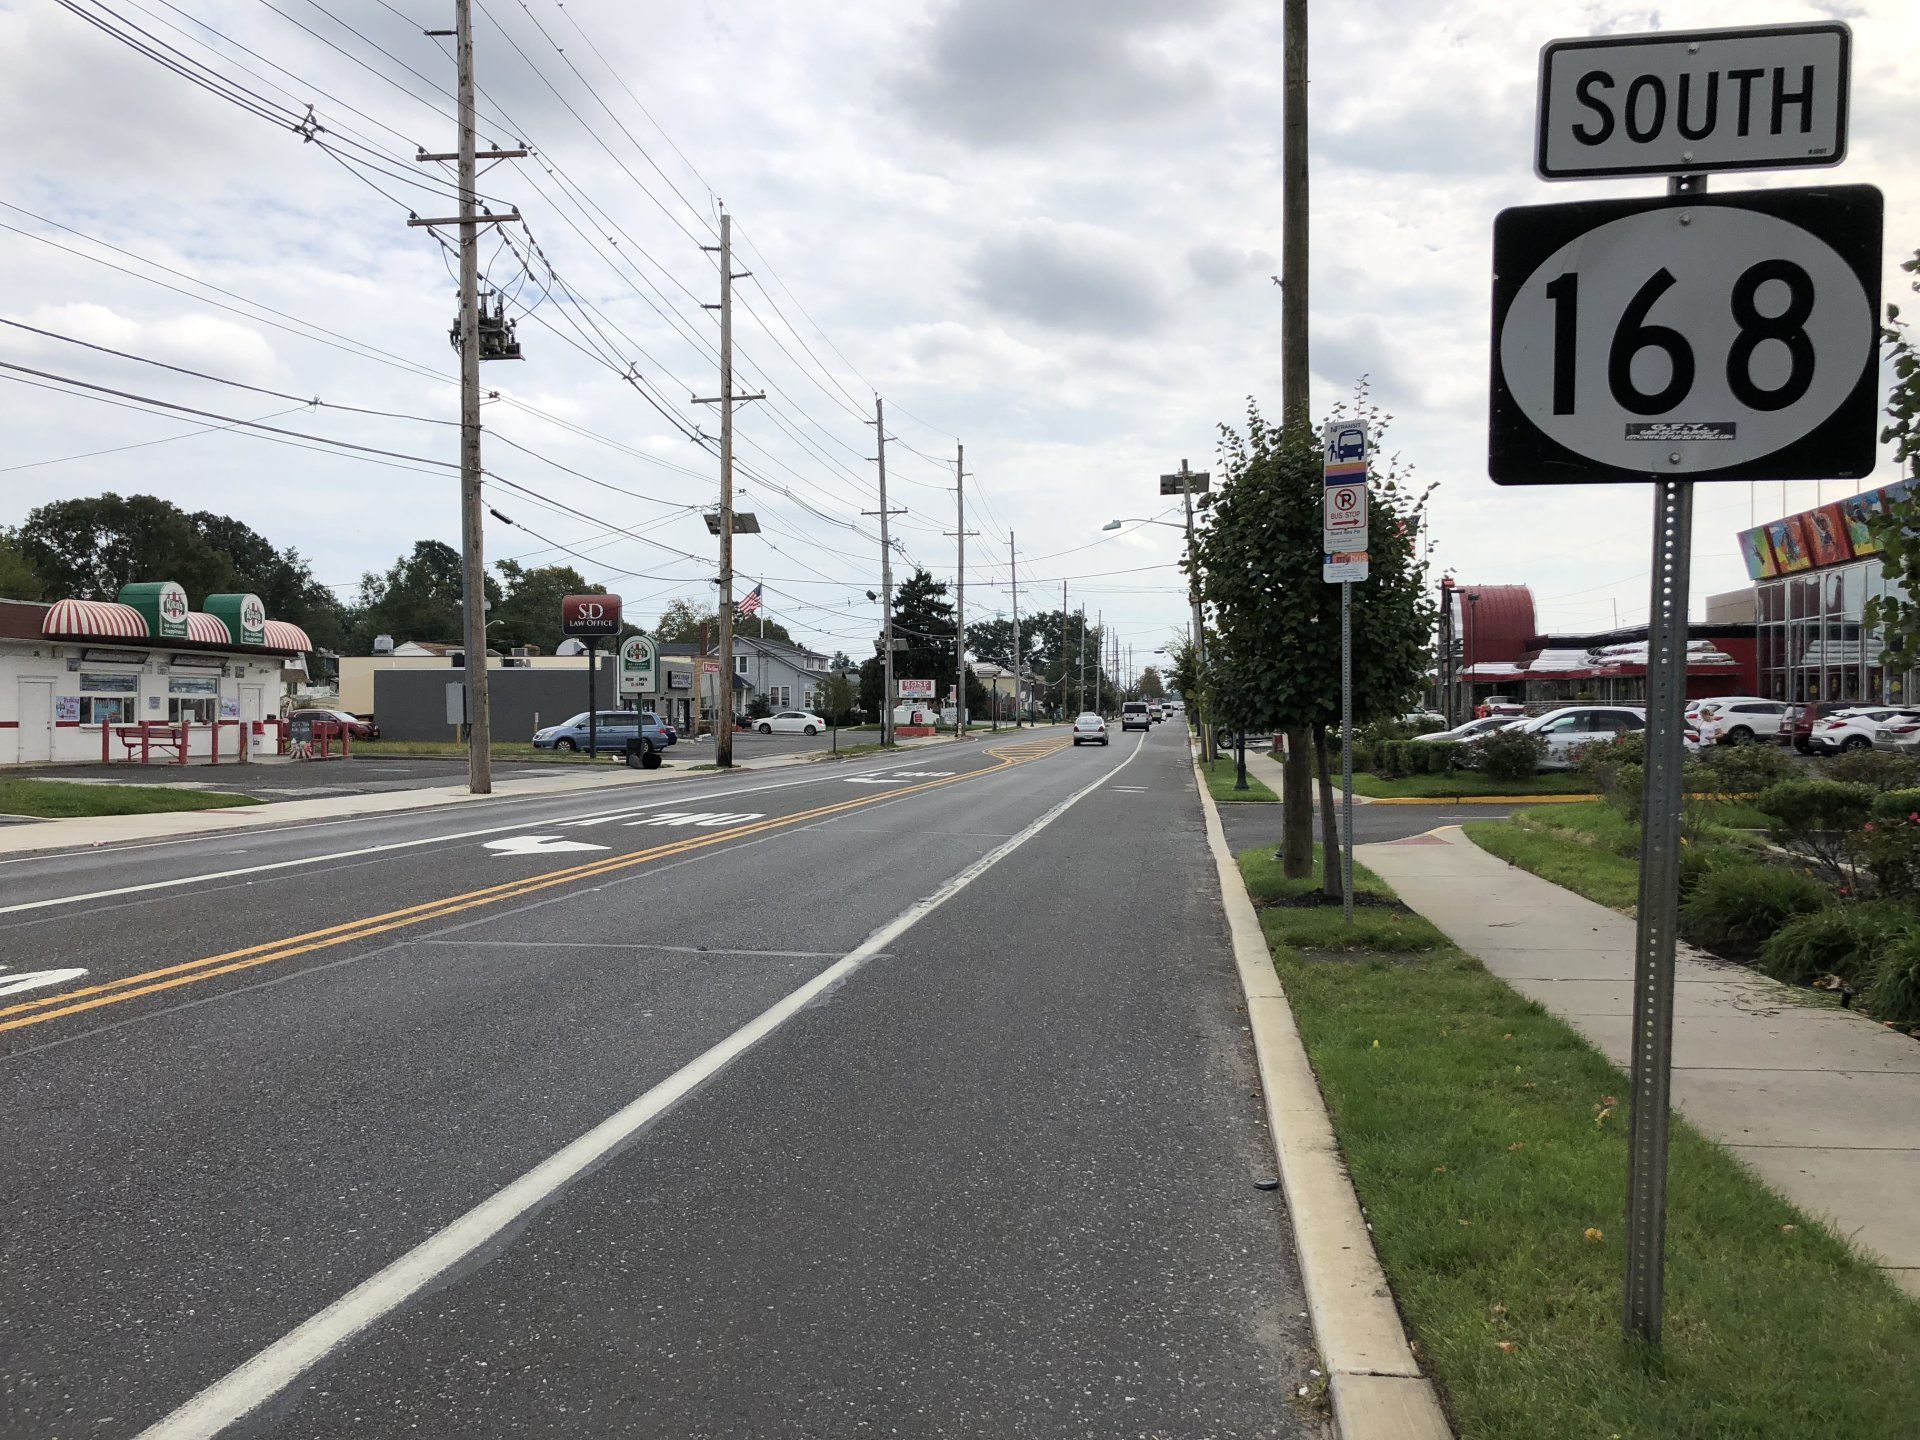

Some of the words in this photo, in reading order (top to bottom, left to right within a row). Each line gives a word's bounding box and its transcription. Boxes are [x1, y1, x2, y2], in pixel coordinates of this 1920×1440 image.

[1571, 65, 1815, 146] SOUTH
[1546, 258, 1816, 416] 168
[1344, 510, 1361, 518] STOP
[569, 619, 585, 627] LAW
[586, 619, 613, 627] OFFICE
